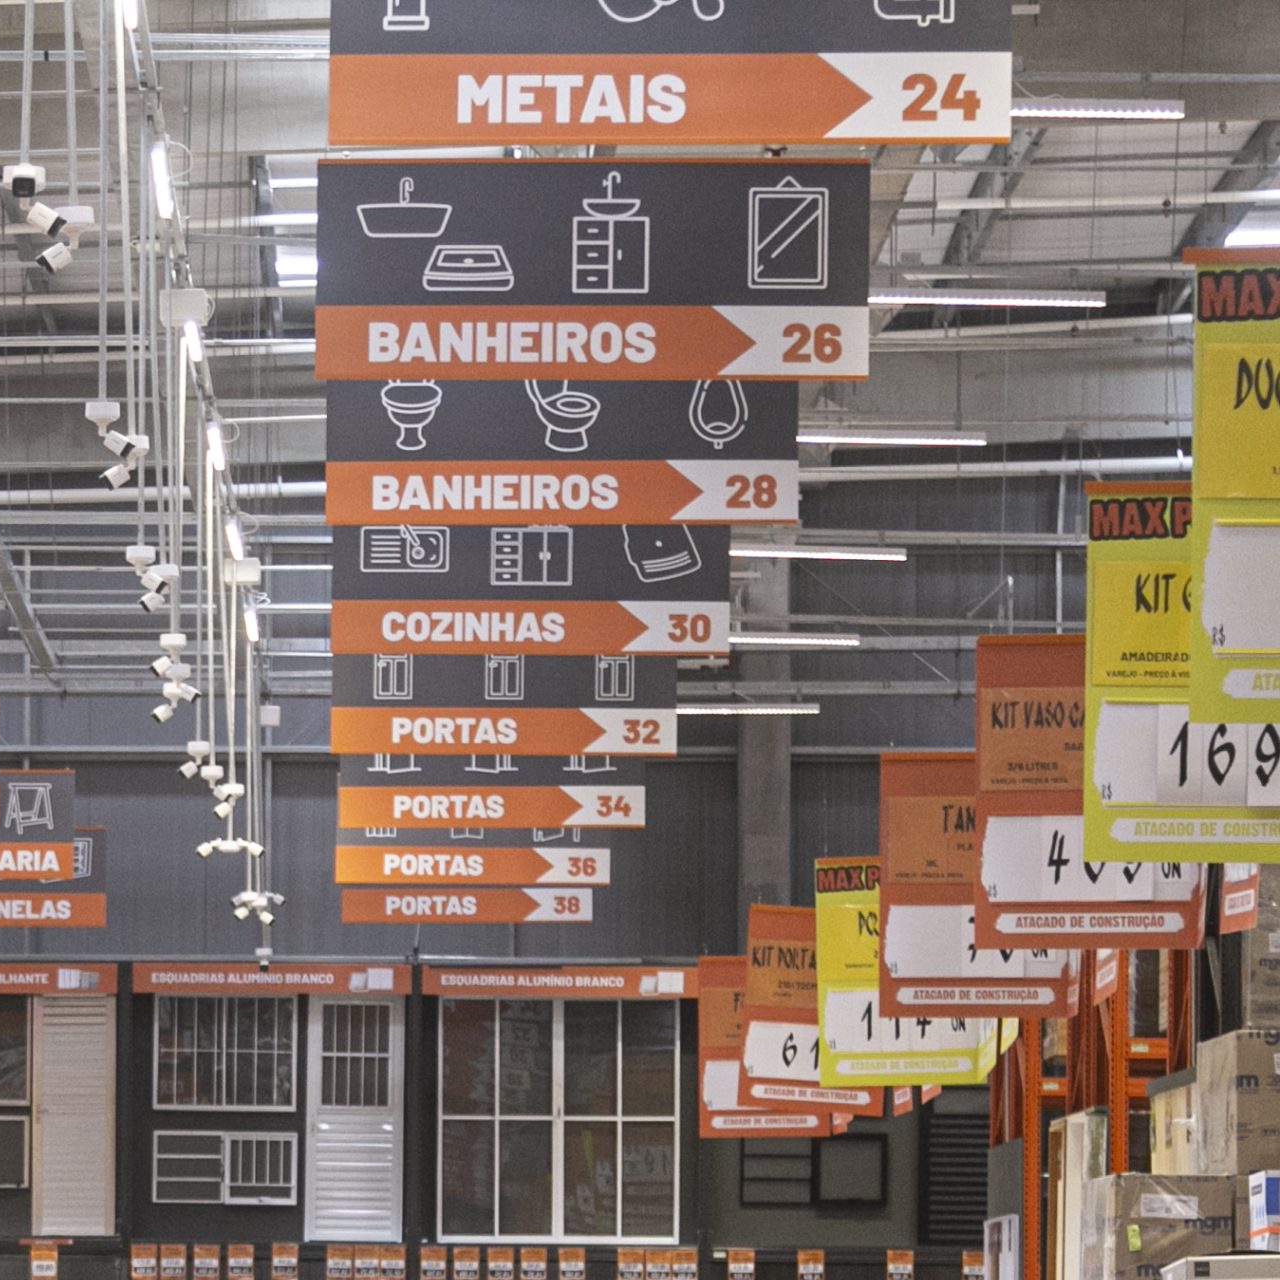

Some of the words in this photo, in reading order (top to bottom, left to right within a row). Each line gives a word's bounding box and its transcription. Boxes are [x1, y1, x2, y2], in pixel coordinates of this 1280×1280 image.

[457, 73, 686, 124] METAIS
[901, 73, 981, 122] 24
[368, 321, 656, 364] BANHEIROS
[782, 323, 842, 364] 26
[372, 474, 619, 510] BANHEIROS
[726, 475, 778, 509] 28
[1090, 498, 1169, 540] MAX
[1135, 573, 1176, 614] KIT
[382, 612, 565, 643] COZINHAS
[668, 614, 711, 643] 30
[991, 701, 1019, 730] KIT
[1024, 701, 1064, 729] VASO
[391, 717, 517, 744] PORTAS
[623, 719, 660, 744] 32
[393, 795, 504, 819] PORTAS
[597, 795, 632, 818] 34
[1134, 823, 1194, 836] ATACADO
[1200, 823, 1217, 836] DE
[384, 854, 483, 876] PORTAS
[568, 857, 597, 877] 36
[816, 866, 862, 892] MAX
[385, 896, 477, 915] PORTAS
[554, 897, 580, 915] 38
[1015, 916, 1065, 928] ATACADO
[1070, 916, 1083, 928] DE
[1089, 914, 1165, 930] CONSTRUÇÃO
[151, 972, 225, 984] ESQUADRIAS
[286, 974, 334, 985] BRANCO
[441, 975, 515, 987] ESQUADRIAS
[518, 973, 573, 987] ALUMÍNIO
[576, 976, 625, 988] BRANCO
[913, 990, 956, 1000] ATACADO
[959, 990, 971, 1000] DE
[975, 988, 1039, 1002] CONSTRUÇÃO
